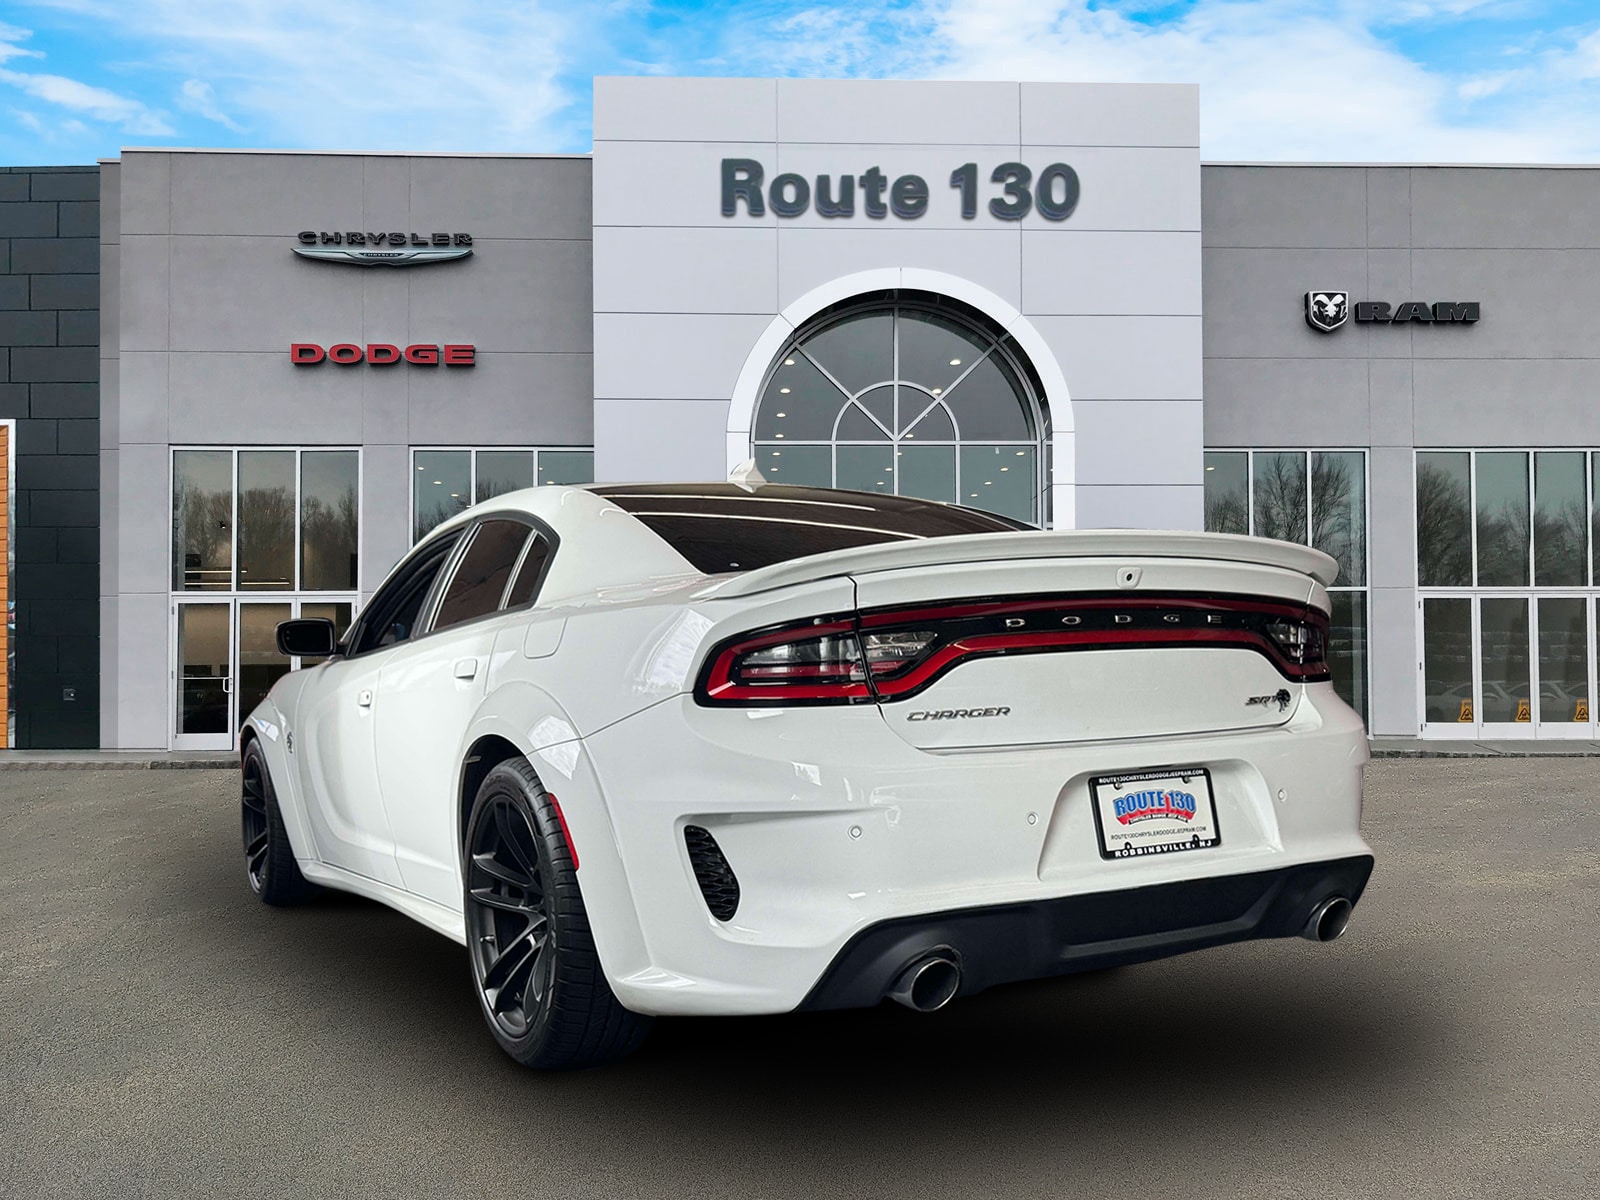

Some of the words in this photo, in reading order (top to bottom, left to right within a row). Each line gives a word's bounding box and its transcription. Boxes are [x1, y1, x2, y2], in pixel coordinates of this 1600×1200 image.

[721, 158, 929, 218] Route
[951, 162, 1080, 221] 130
[297, 231, 472, 246] CHRYSLER
[1355, 302, 1480, 323] RAM
[291, 343, 476, 367] DODGE
[1005, 614, 1223, 628] DODGE
[906, 706, 1011, 721] CHARGER
[1113, 790, 1165, 817] ROUTE
[1168, 790, 1196, 813] 130
[1115, 842, 1195, 857] ROBBINSVILLE,
